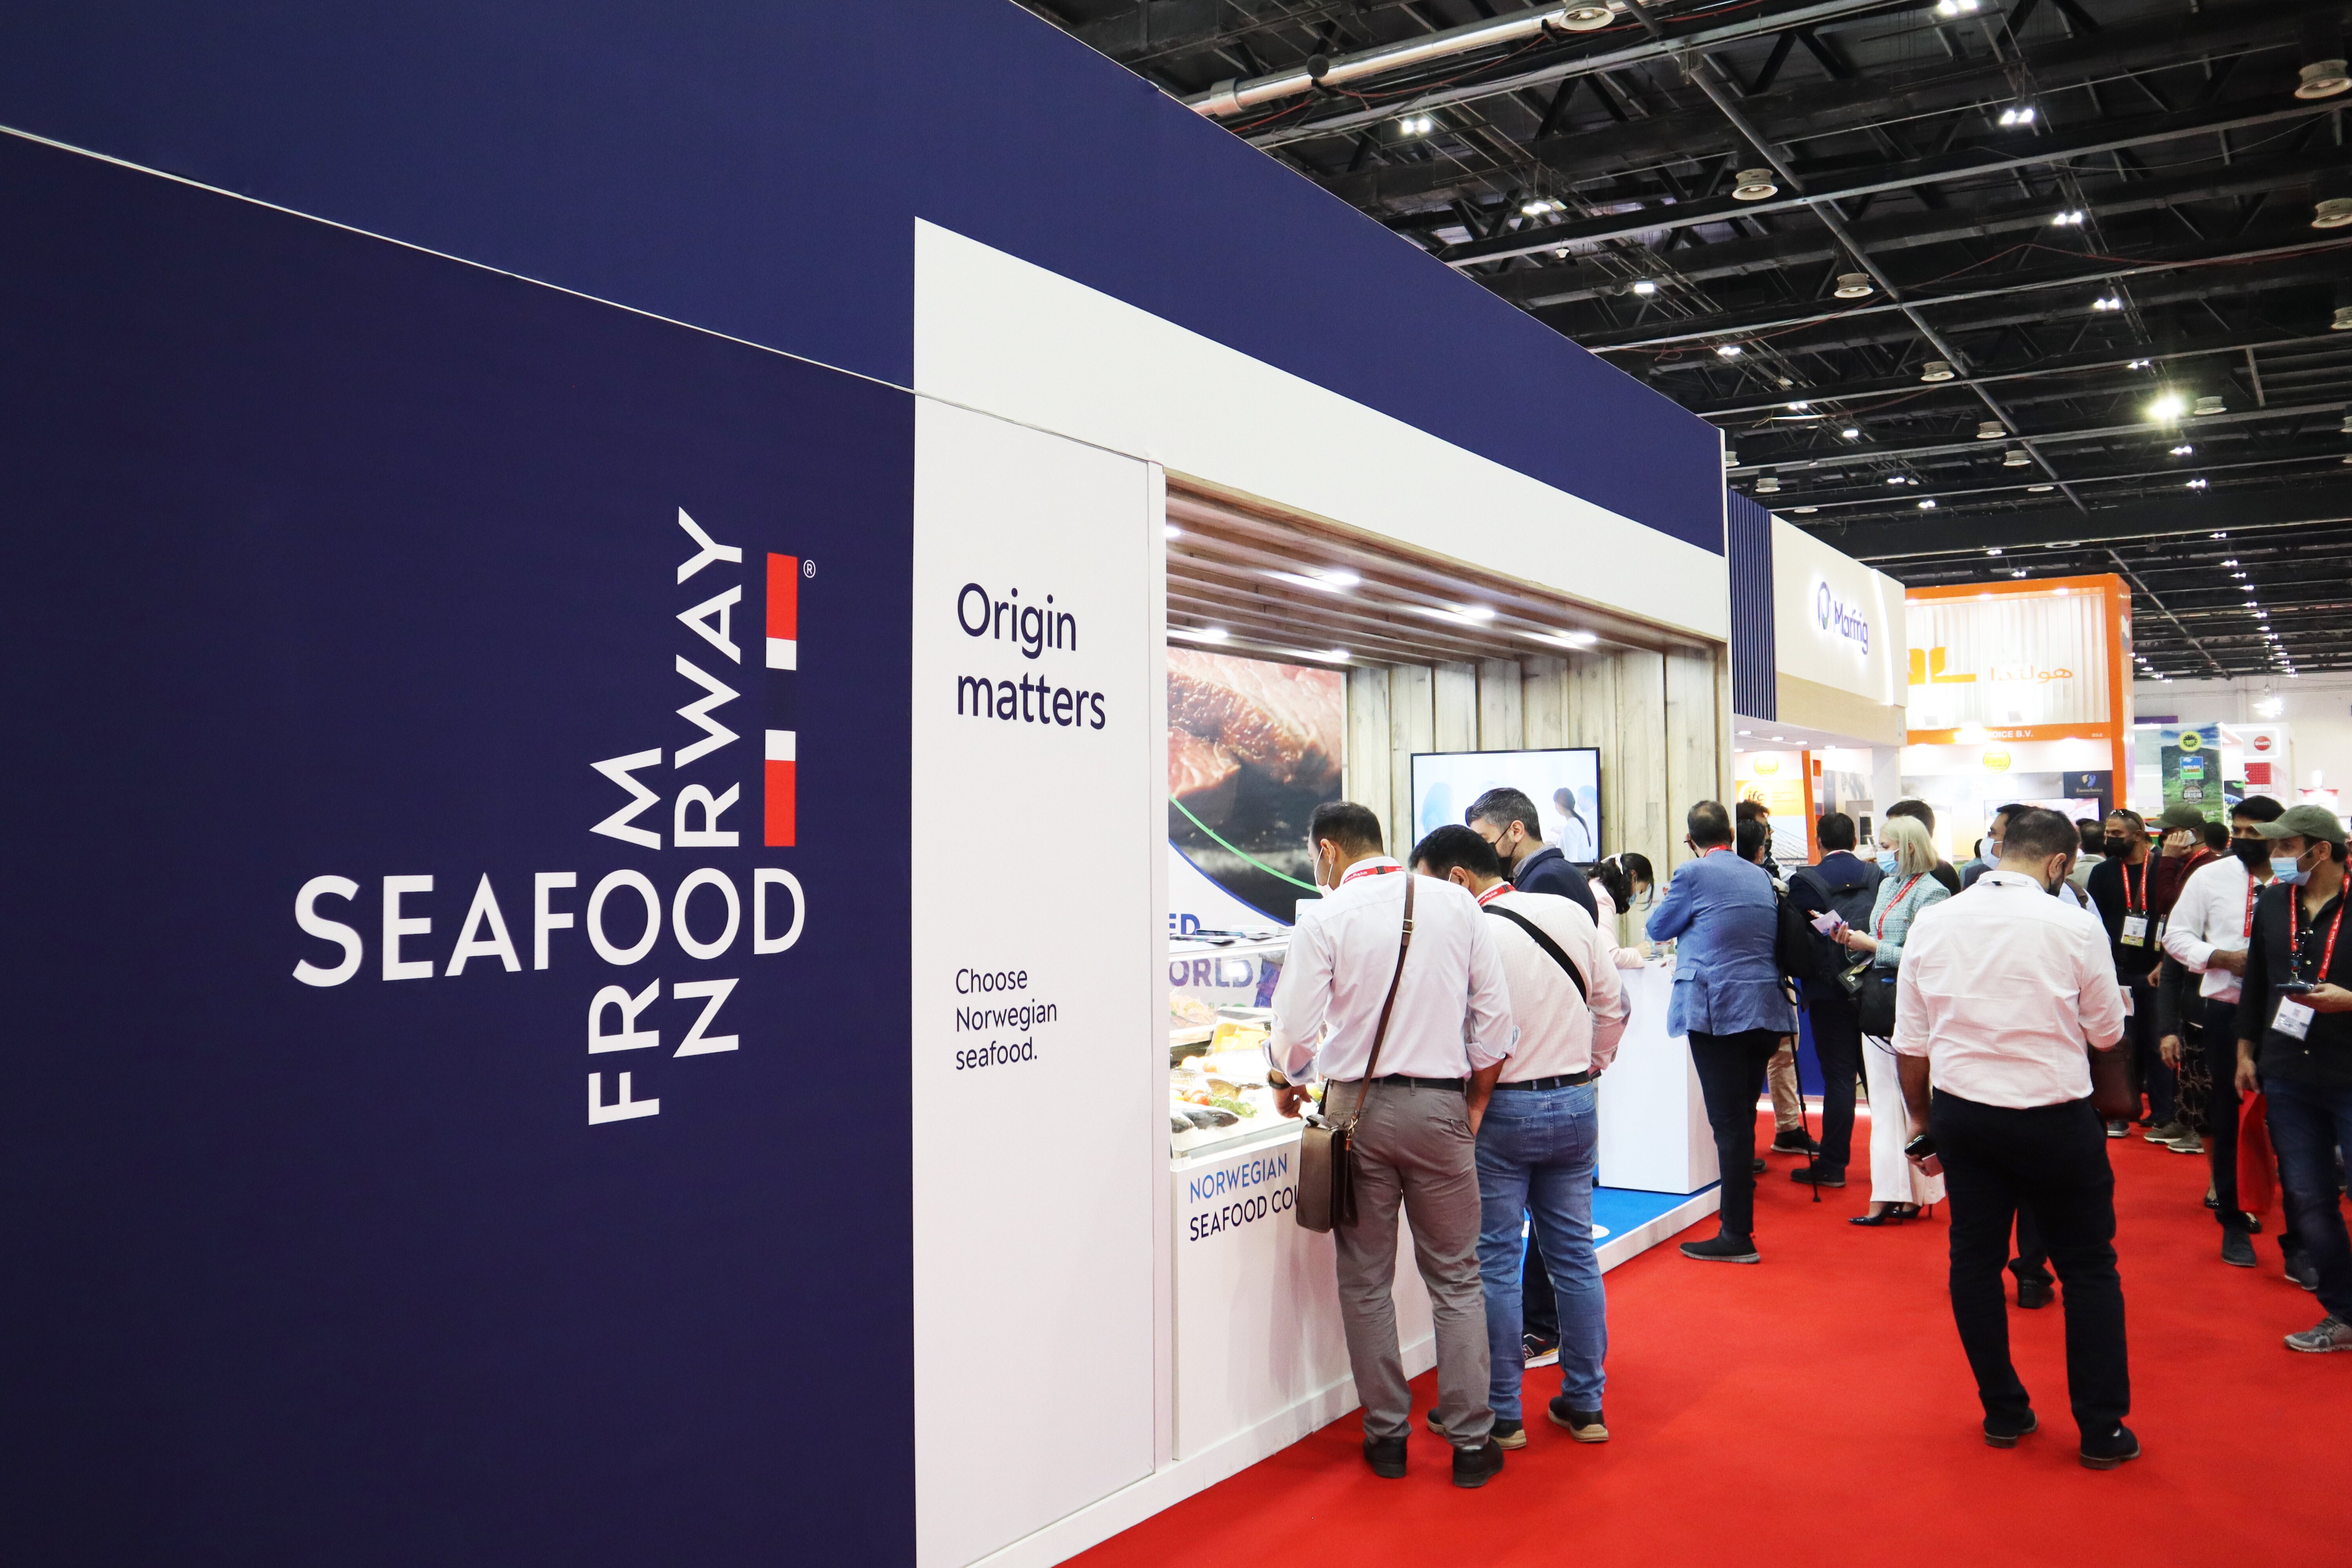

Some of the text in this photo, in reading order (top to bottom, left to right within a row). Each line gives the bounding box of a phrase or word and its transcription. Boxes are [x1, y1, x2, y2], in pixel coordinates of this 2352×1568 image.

[958, 583, 1076, 659] Origin
[1991, 665, 2073, 684] هولندا
[958, 672, 1105, 730] matters
[673, 506, 742, 1058] NORWAY
[292, 867, 805, 987] SEAFOOD
[588, 747, 662, 1125] FROM
[956, 968, 1027, 994] Choose
[1169, 958, 1253, 987] ORLD
[956, 998, 1057, 1032] Norwegian
[956, 1036, 1038, 1070] seafood.
[1190, 1153, 1287, 1204] NORWEGIAN
[1190, 1196, 1267, 1241] SEAFOOD
